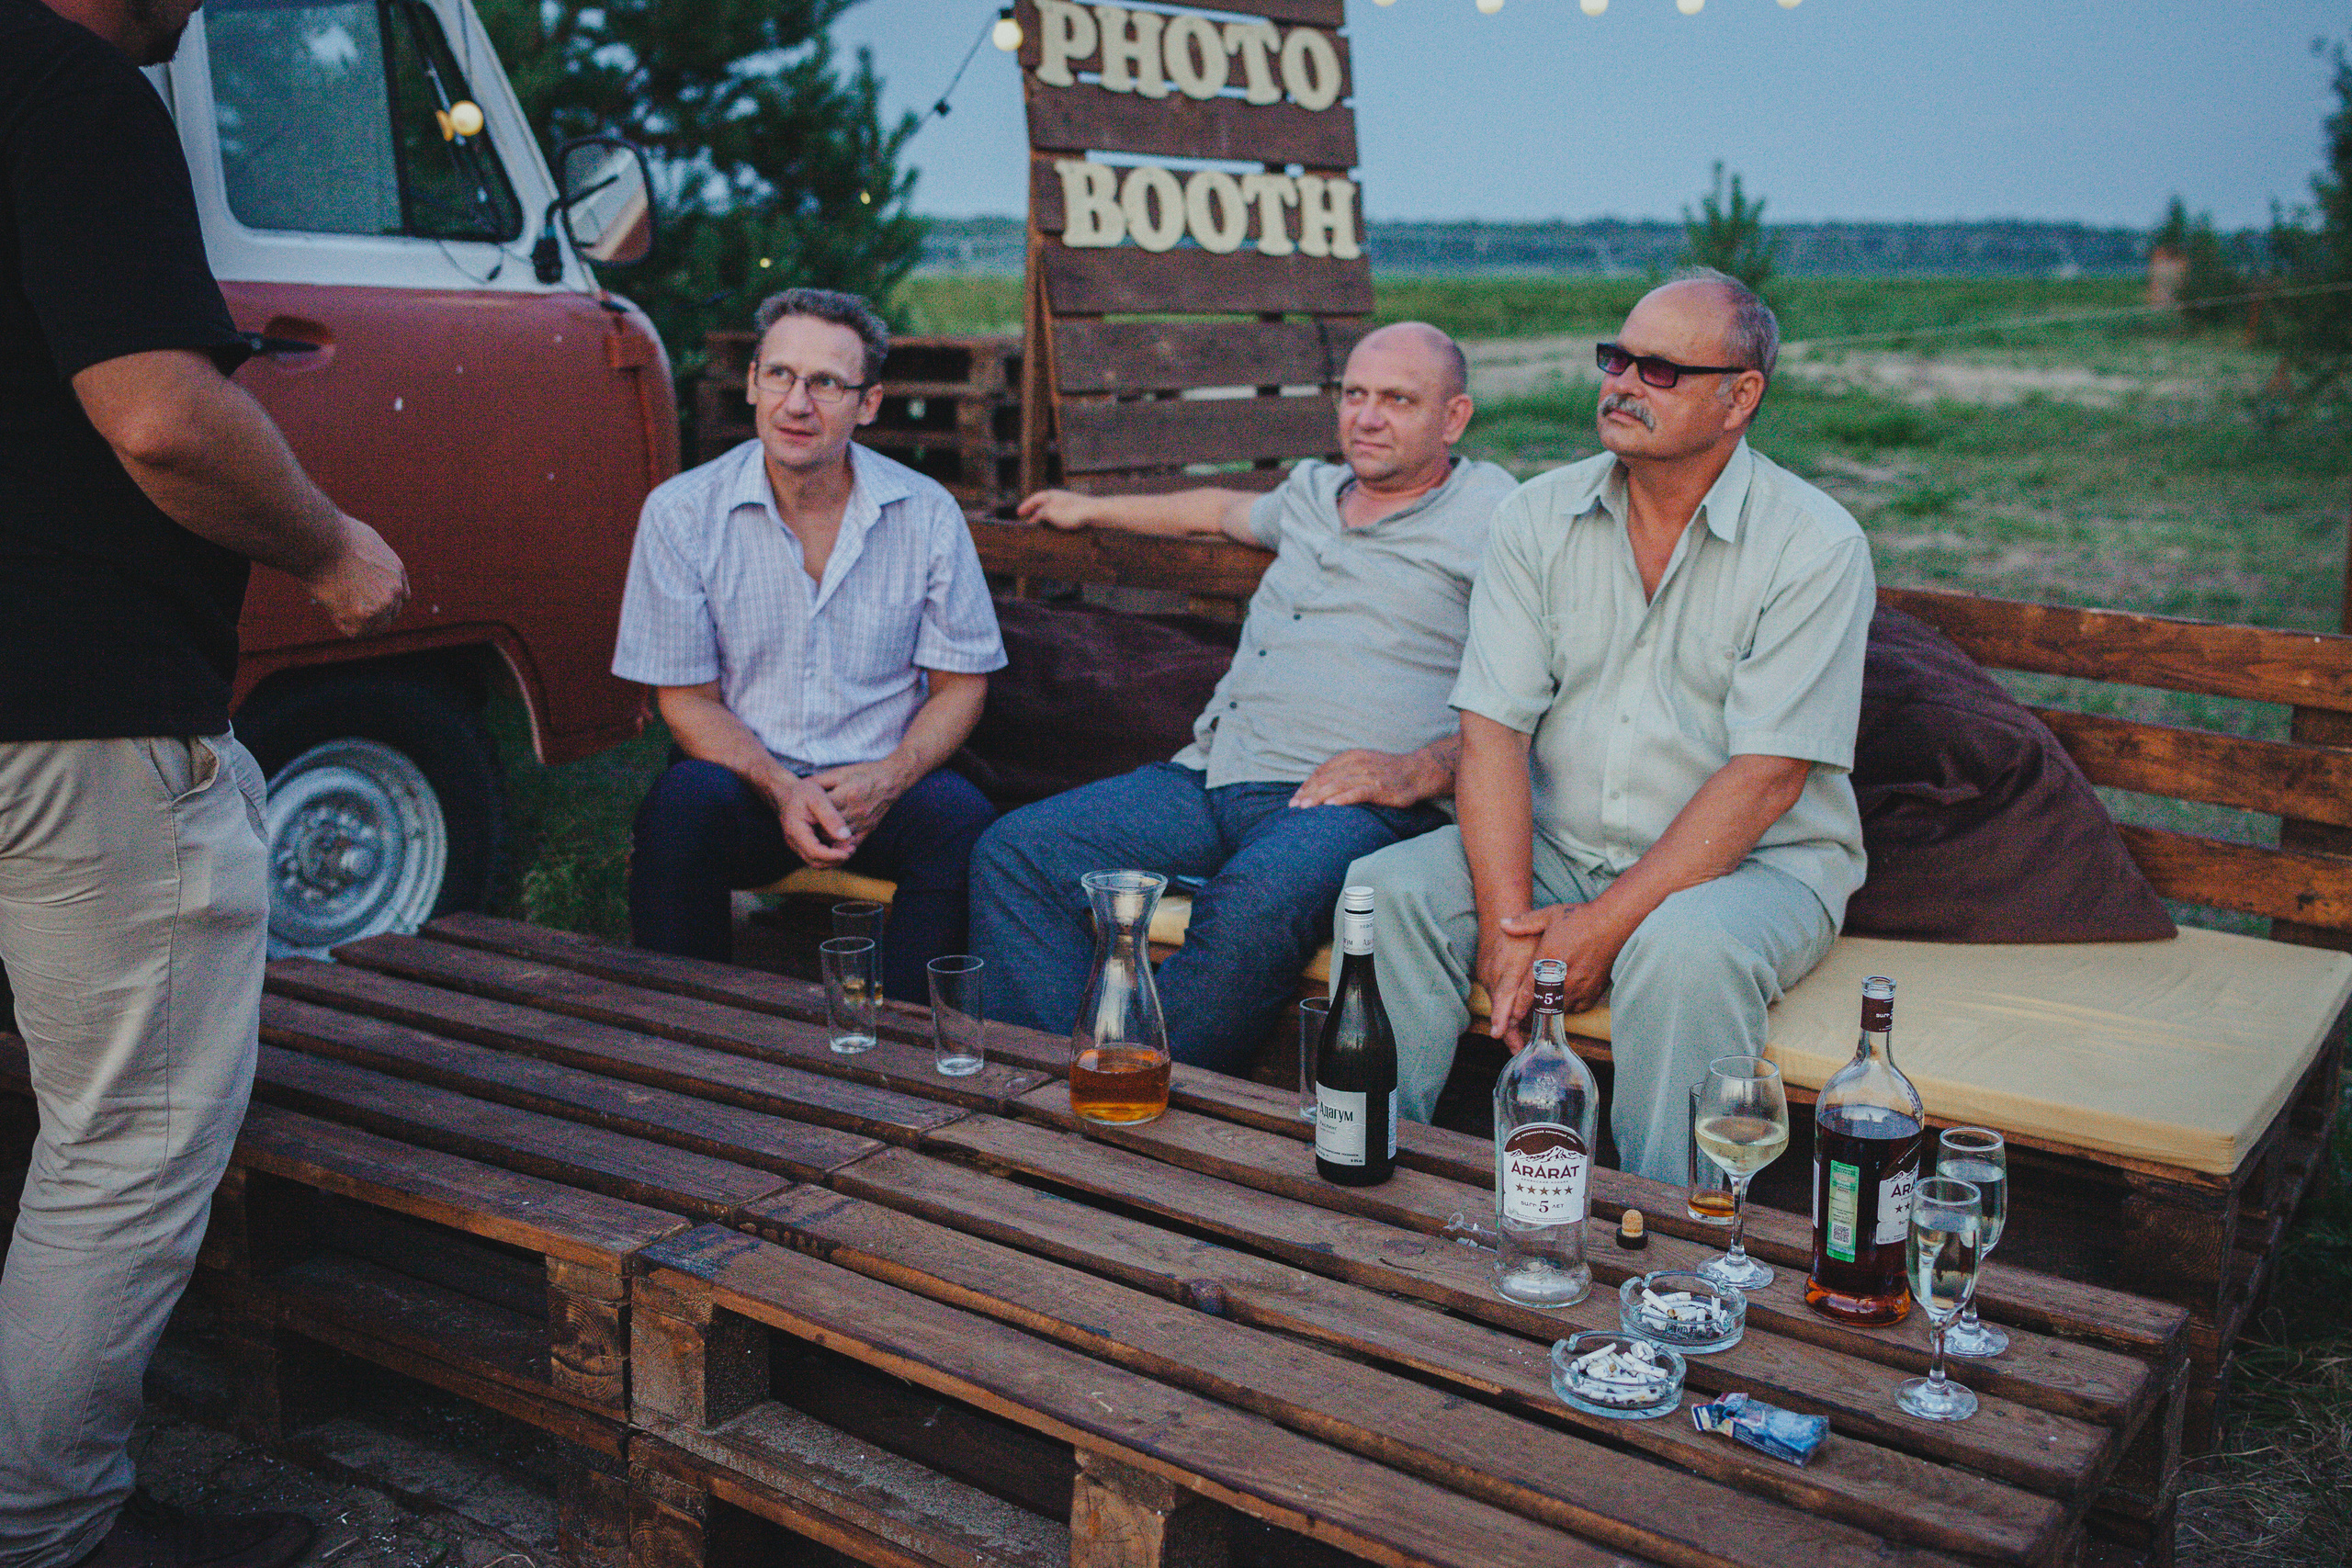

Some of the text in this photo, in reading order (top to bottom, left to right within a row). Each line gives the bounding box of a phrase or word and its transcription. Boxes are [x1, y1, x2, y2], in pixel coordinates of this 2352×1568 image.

[1035, 0, 1342, 111] PHOTO
[1056, 159, 1362, 259] BOOTH
[1544, 992, 1554, 1005] 5
[1319, 1100, 1353, 1123] Адагум
[1510, 1159, 1580, 1179] ARARAT
[1538, 1200, 1549, 1213] 5
